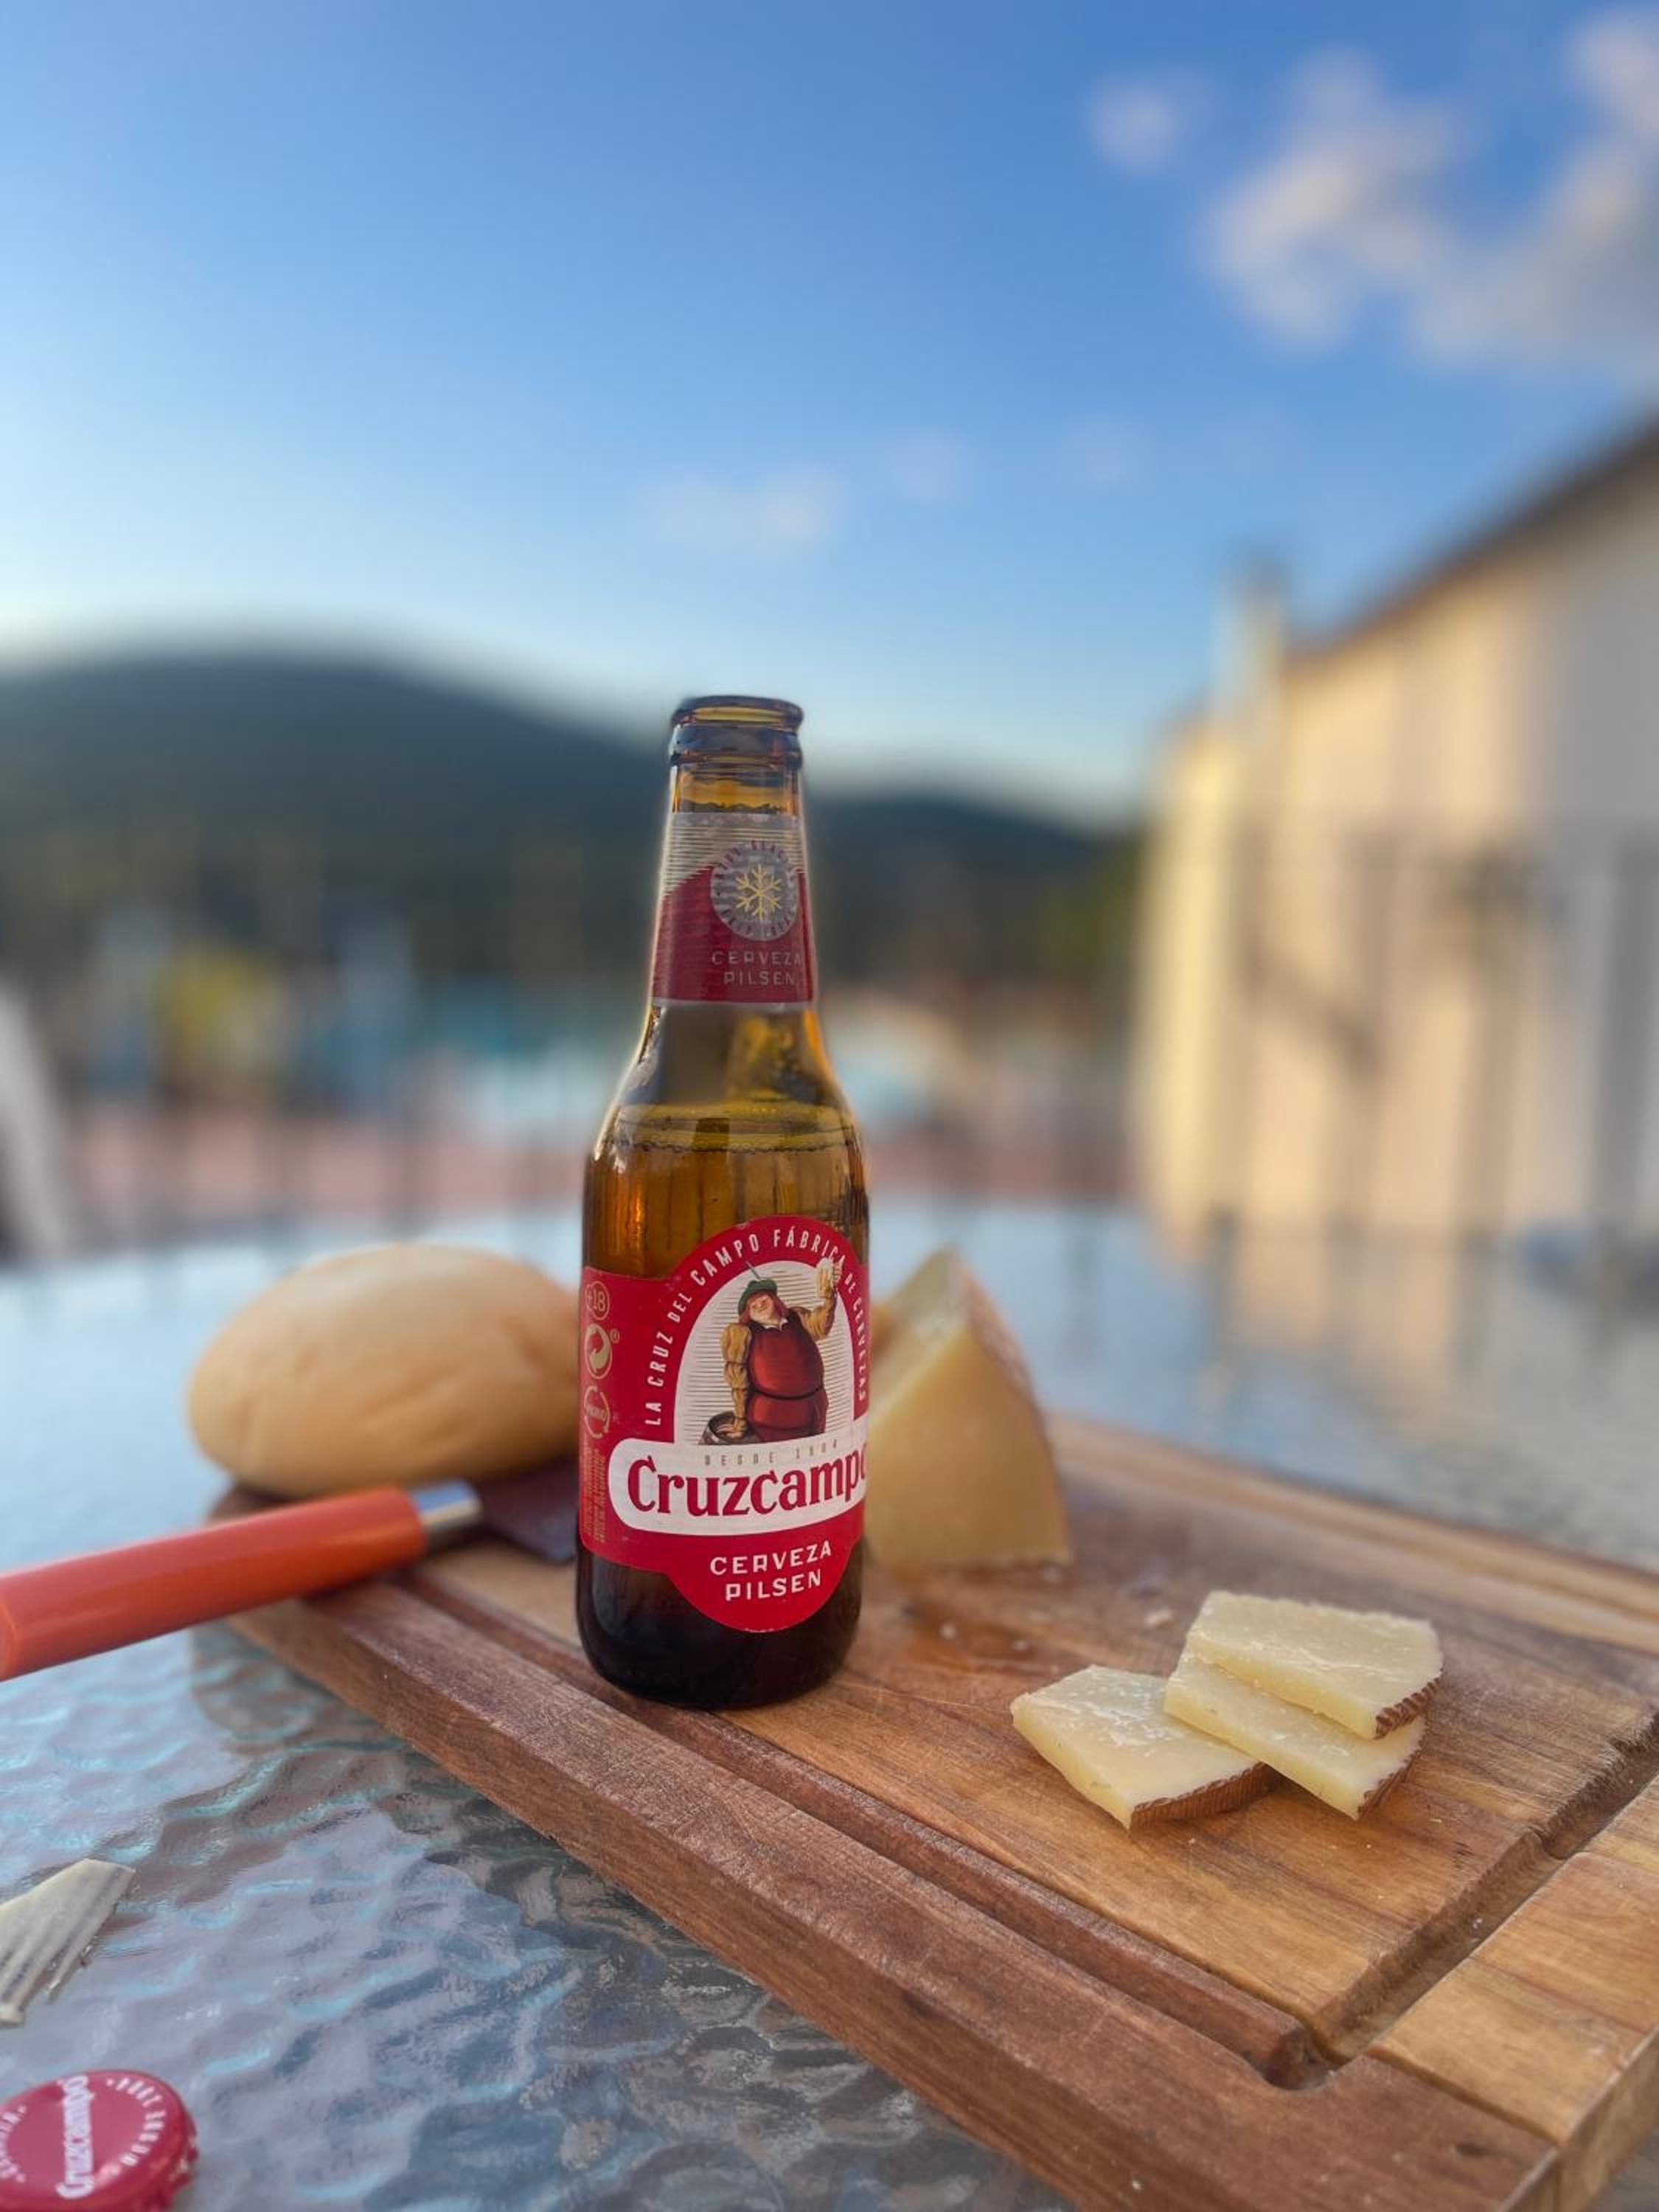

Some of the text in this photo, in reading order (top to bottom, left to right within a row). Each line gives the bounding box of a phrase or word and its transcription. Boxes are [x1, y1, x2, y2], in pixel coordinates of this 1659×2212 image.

[712, 951, 801, 966] CERVEZA
[724, 970, 796, 985] PILSEN
[690, 1234, 760, 1286] CAMPO
[844, 1272, 856, 1294] DE
[668, 1292, 692, 1323] DEL
[647, 1331, 674, 1387] CRUZ
[852, 1297, 866, 1401] CERVEZAS
[646, 1402, 661, 1425] LA
[710, 1540, 832, 1576] CERVEZA
[726, 1568, 821, 1601] PILSEN
